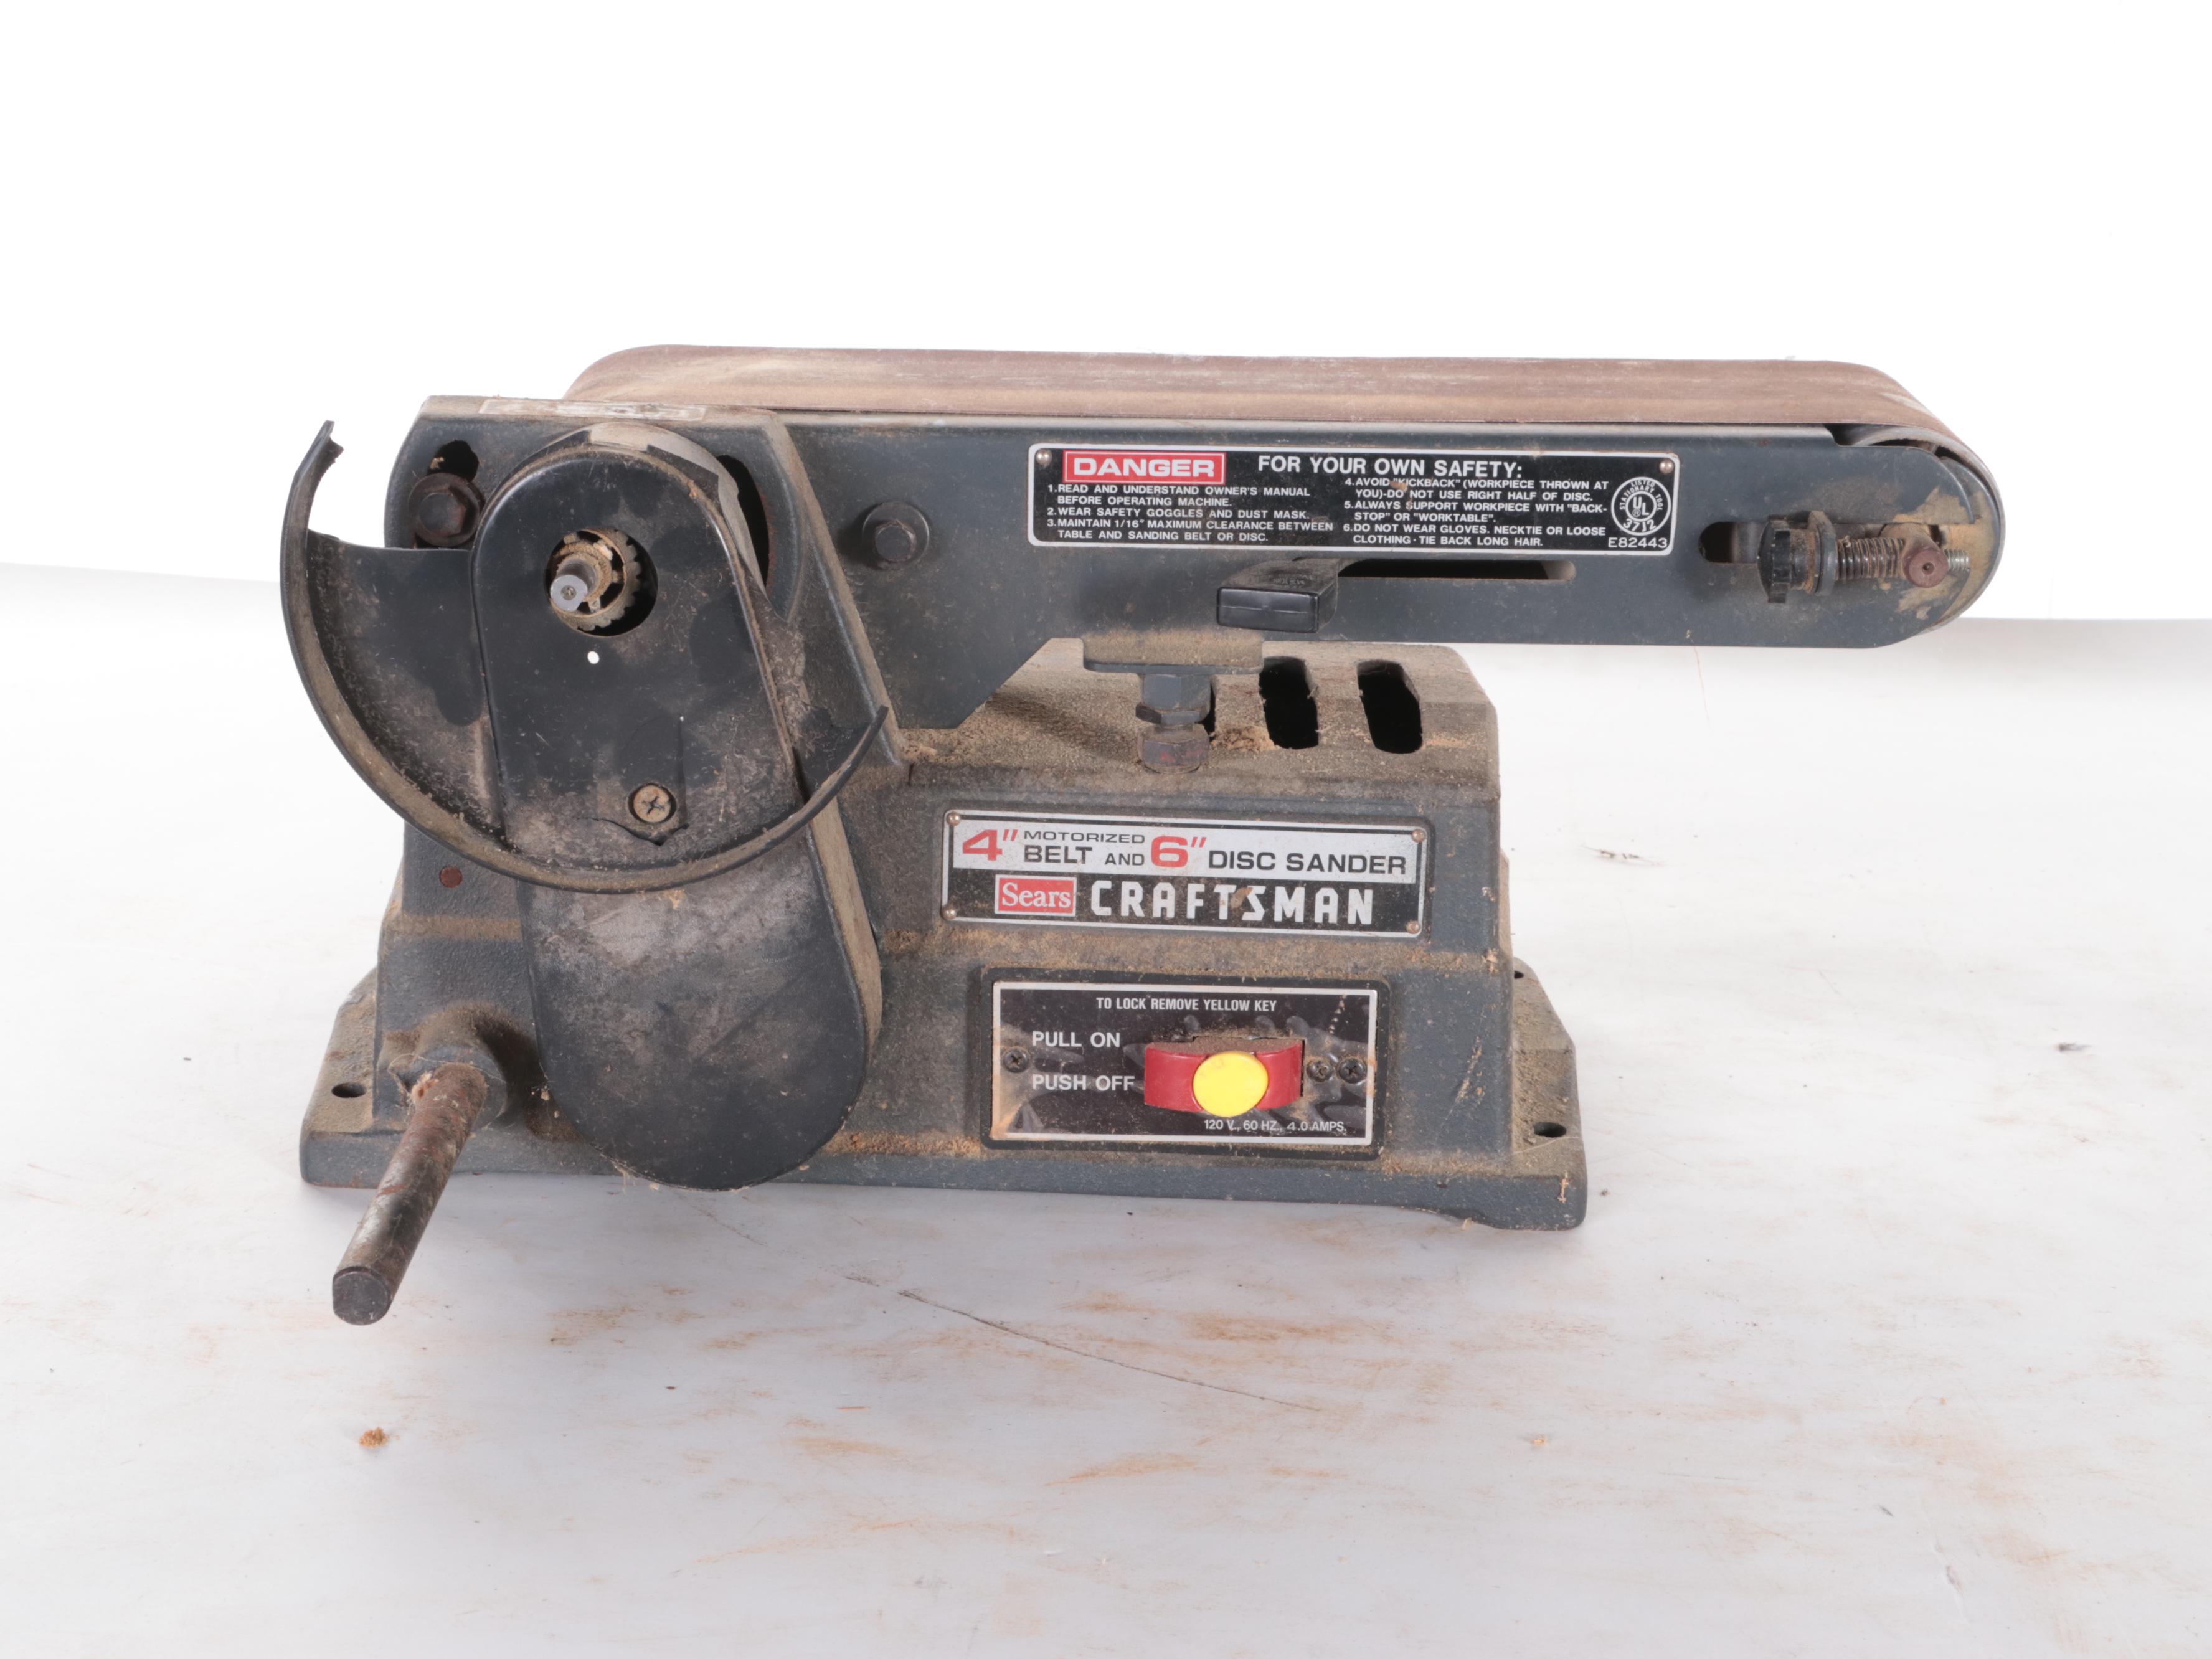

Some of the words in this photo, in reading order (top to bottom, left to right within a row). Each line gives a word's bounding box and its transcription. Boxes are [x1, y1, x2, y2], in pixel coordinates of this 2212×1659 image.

[1074, 456, 1214, 478] DANGER
[1259, 455, 1300, 472] FOR
[1310, 457, 1366, 474] YOUR
[1374, 458, 1425, 475] OWN
[1434, 460, 1523, 478] SAFETY:
[1094, 484, 1118, 493] AND
[1123, 486, 1199, 495] UNDERSTAND
[1205, 486, 1257, 496] OWNER'S
[1264, 488, 1310, 496] MANUAL
[1463, 479, 1534, 489] (WORKPIECE
[1539, 480, 1589, 489] THROWN
[1594, 481, 1609, 489] AT
[1057, 496, 1102, 504] BEFORE
[1108, 496, 1171, 506] OPERATING
[1178, 498, 1232, 506] MACHINE.
[1409, 490, 1434, 499] NOT
[1439, 491, 1462, 499] USE
[1468, 491, 1501, 499] RIGHT
[1508, 491, 1536, 500] HALF
[1542, 492, 1557, 501] OF
[1563, 493, 1593, 501] DISC.
[1619, 485, 1655, 510] STATIONARY
[1655, 493, 1663, 511] TOOL
[1406, 501, 1458, 510] SUPPORT
[1463, 502, 1530, 511] WORKPIECE
[1535, 503, 1564, 512] WITH
[1567, 504, 1607, 513] "BACK-
[1097, 508, 1141, 516] SAFETY
[1146, 509, 1203, 518] GOGGLES
[1209, 510, 1232, 518] AND
[1238, 511, 1268, 519] DUST
[1274, 511, 1309, 519] MASK.
[1354, 512, 1391, 521] STOP"
[1394, 513, 1410, 521] OR
[1148, 520, 1201, 529] MAXIMUM
[1206, 521, 1274, 530] CLEARANCE
[1278, 522, 1333, 531] BETWEEN
[1374, 524, 1399, 532] NOT
[1403, 524, 1436, 533] WEAR
[1440, 525, 1490, 534] GLOVES.
[1494, 526, 1542, 534] NECKTIE
[1546, 526, 1562, 535] OR
[1567, 527, 1606, 536] LOOSE
[1058, 530, 1092, 539] TABLE
[1099, 531, 1122, 539] AND
[1128, 531, 1179, 540] SANDING
[1184, 532, 1211, 541] BELT
[1217, 532, 1234, 541] OR
[1239, 532, 1268, 541] DISC.
[1353, 535, 1411, 544] CLOTHING
[1419, 536, 1435, 544] TIE
[1440, 536, 1472, 545] BACK
[1477, 537, 1509, 546] LONG
[1514, 537, 1543, 546] HAIR.
[1608, 537, 1668, 549] E82443
[962, 829, 1018, 861] 4"
[1023, 830, 1145, 844] MOTORIZED
[1023, 844, 1093, 864] BELT
[1104, 851, 1145, 866] AND
[1150, 836, 1206, 868] 6"
[1208, 850, 1276, 871] DISC
[1285, 853, 1406, 876] SANDER
[1001, 882, 1072, 909] Sears
[1091, 879, 1373, 925] CRAFTSMAN
[1096, 998, 1112, 1009] TO
[1115, 998, 1146, 1010] LOCK
[1151, 998, 1199, 1011] REMOVE
[1203, 999, 1249, 1011] YELLOW
[1254, 1000, 1276, 1012] KEY
[1032, 1031, 1082, 1047] PULL
[1090, 1032, 1120, 1048] ON
[1032, 1074, 1086, 1090] PUSH
[1095, 1075, 1135, 1091] OFF
[1204, 1120, 1224, 1130] 120
[1243, 1120, 1258, 1130] 60
[1287, 1121, 1308, 1131] 4.0
[1312, 1121, 1346, 1132] AMPS.
